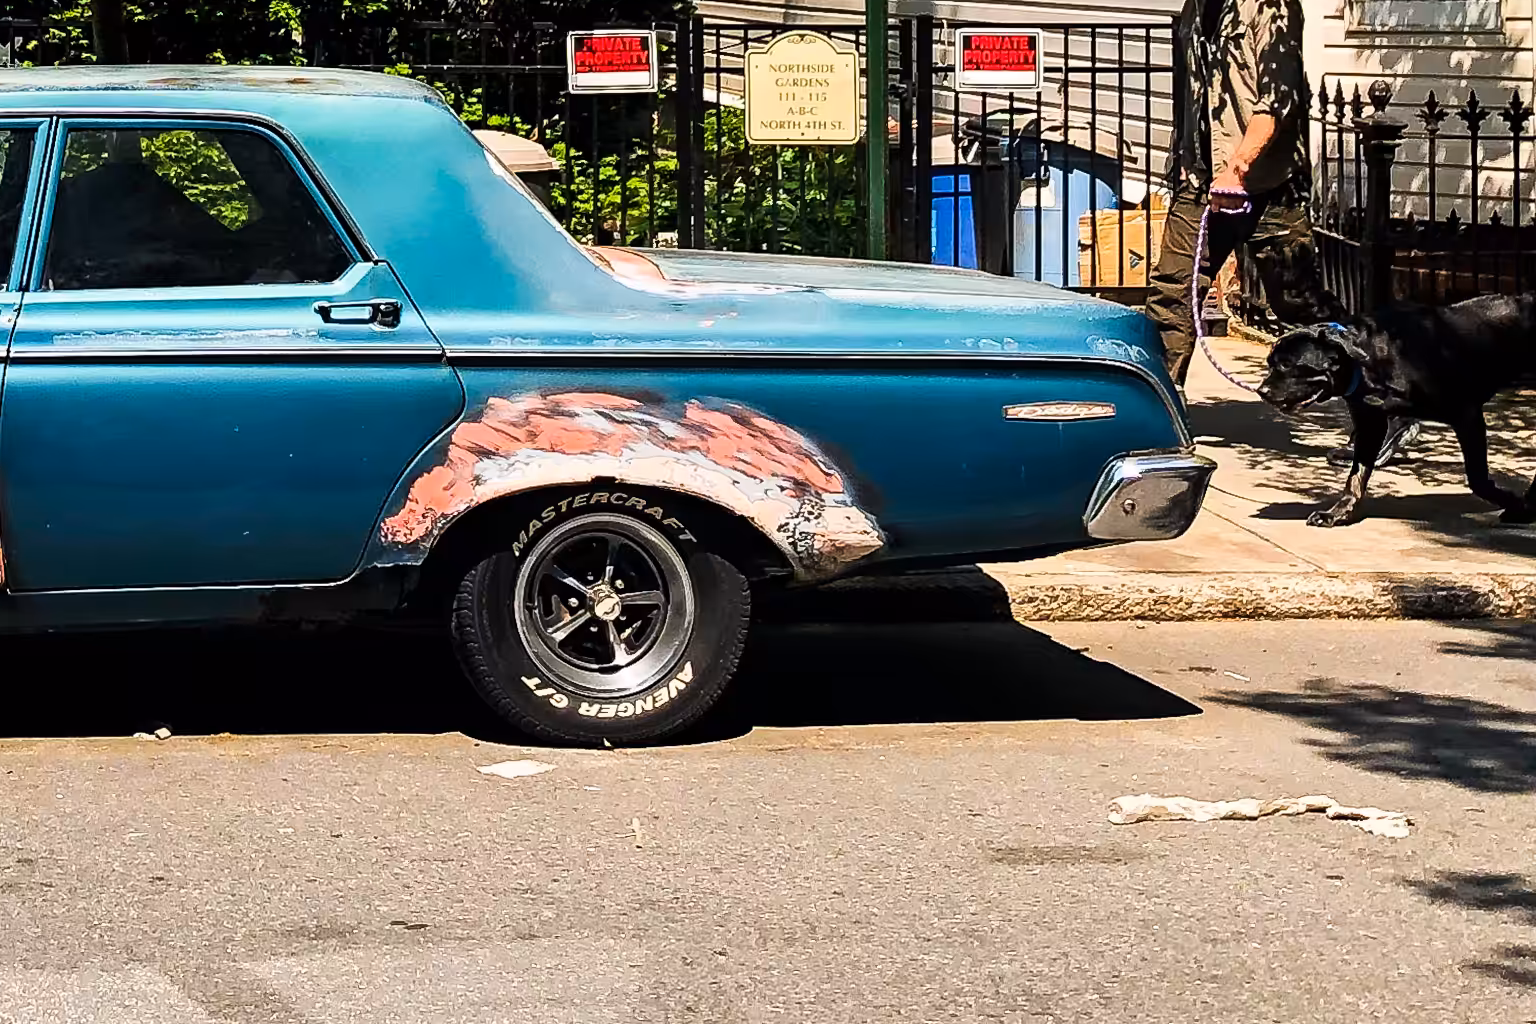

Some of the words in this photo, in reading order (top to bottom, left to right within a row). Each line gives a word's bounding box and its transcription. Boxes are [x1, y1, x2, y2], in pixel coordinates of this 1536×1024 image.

[583, 37, 642, 52] PRIVATE
[971, 36, 1029, 50] PRIVATE
[575, 50, 649, 66] PROPERTY
[964, 49, 1035, 64] PROPERTY
[769, 63, 835, 73] NORTHSIDE
[775, 77, 830, 88] GARDENS
[779, 92, 796, 102] 111
[809, 92, 827, 102] 115
[786, 106, 818, 116] A-B-C
[760, 120, 802, 130] NORTH
[805, 120, 827, 130] 4TH
[1017, 404, 1109, 418] Dodge
[512, 491, 697, 557] MASTERCRAFT
[520, 675, 570, 710] G/T
[577, 660, 694, 719] AVENGER
